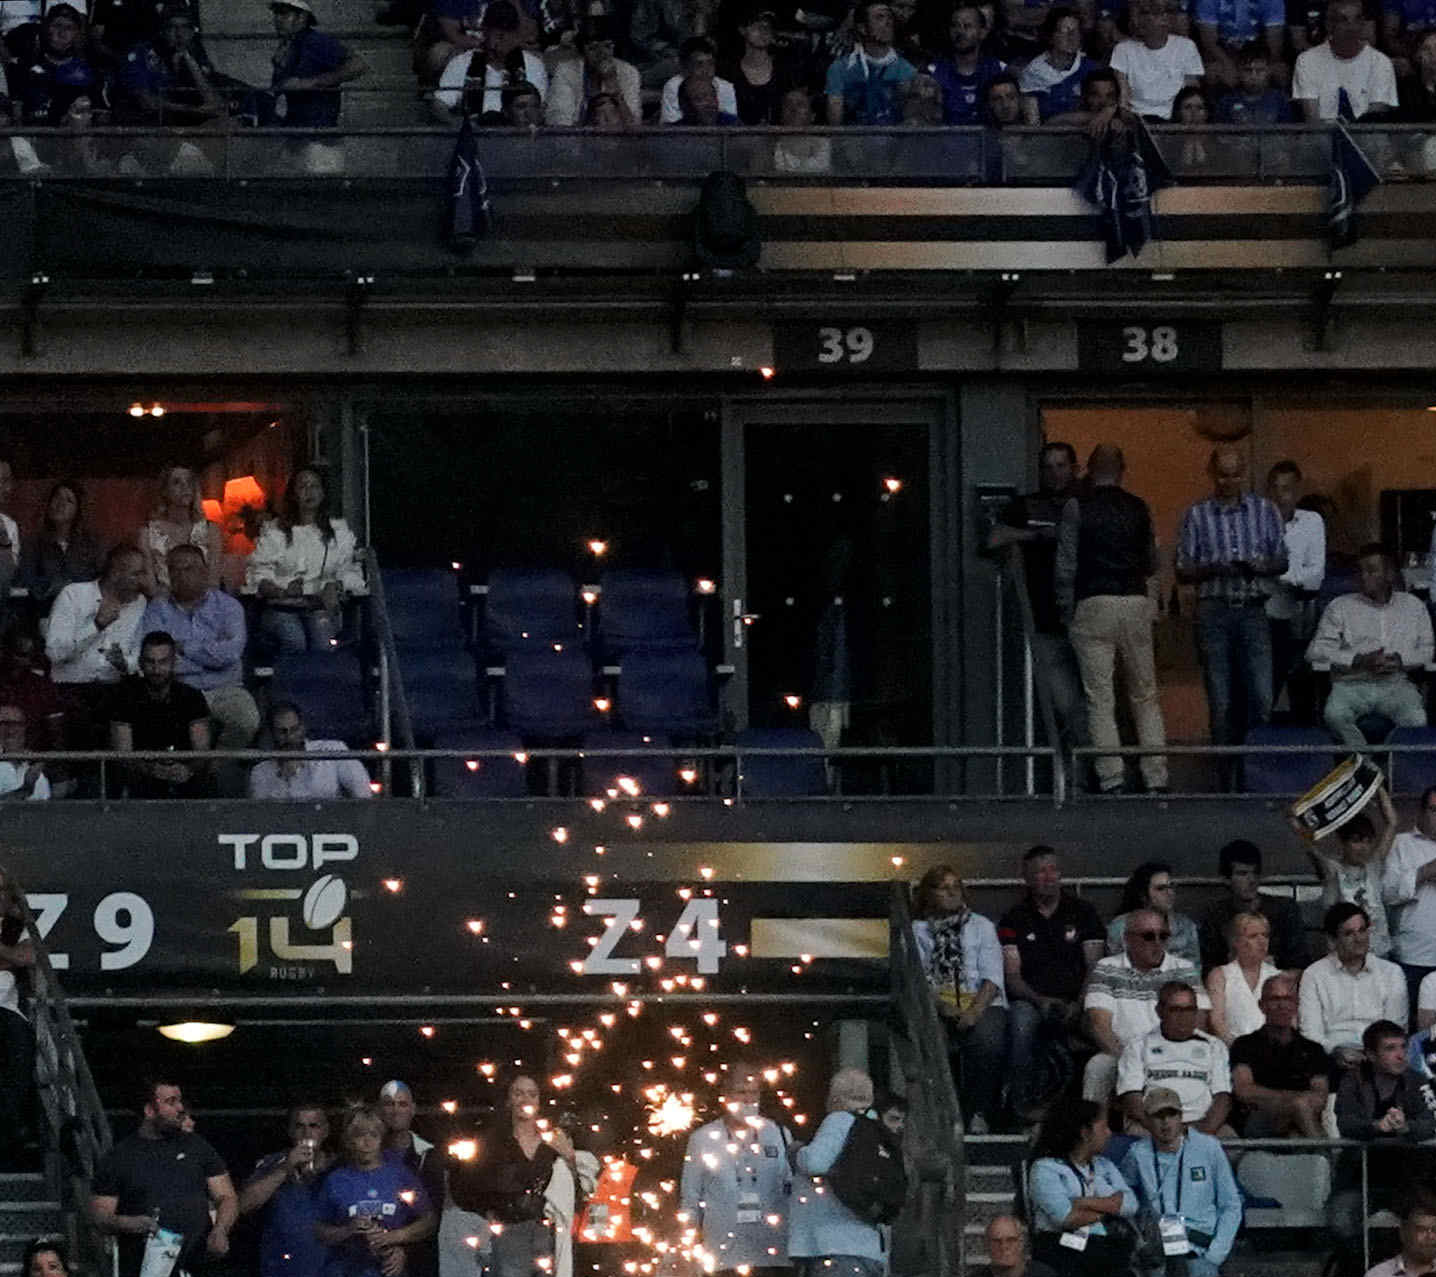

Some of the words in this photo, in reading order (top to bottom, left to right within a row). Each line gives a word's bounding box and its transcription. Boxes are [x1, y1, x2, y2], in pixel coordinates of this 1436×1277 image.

[817, 327, 874, 365] 39
[1121, 326, 1178, 363] 38
[219, 833, 359, 871] TOP
